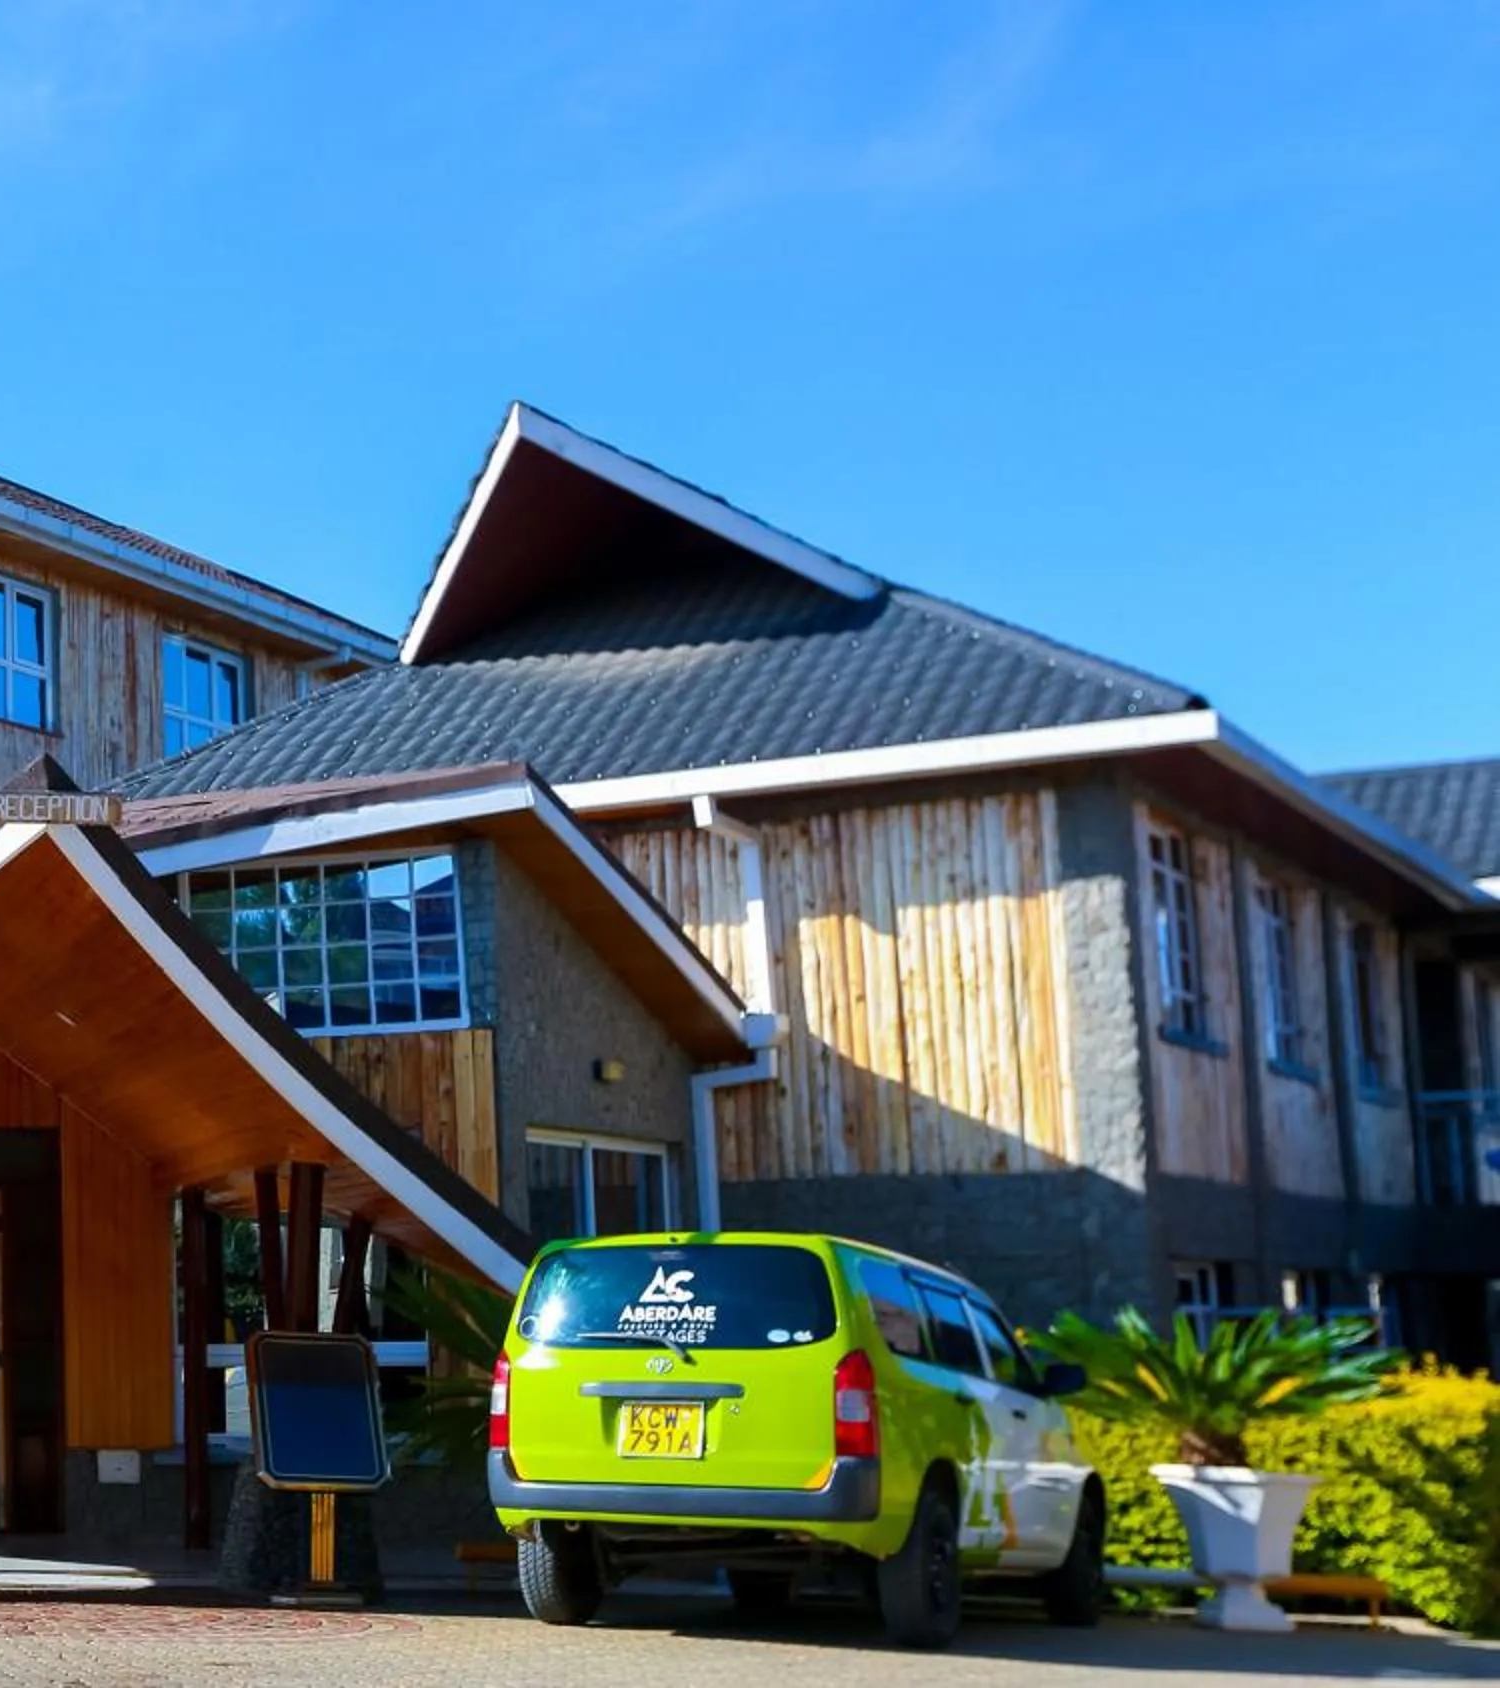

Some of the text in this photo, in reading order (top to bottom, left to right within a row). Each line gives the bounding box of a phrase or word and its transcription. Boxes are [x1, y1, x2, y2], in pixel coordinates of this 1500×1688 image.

[618, 1304, 717, 1323] ABERDARE
[630, 1405, 679, 1429] KCW
[629, 1429, 693, 1453] 791A
